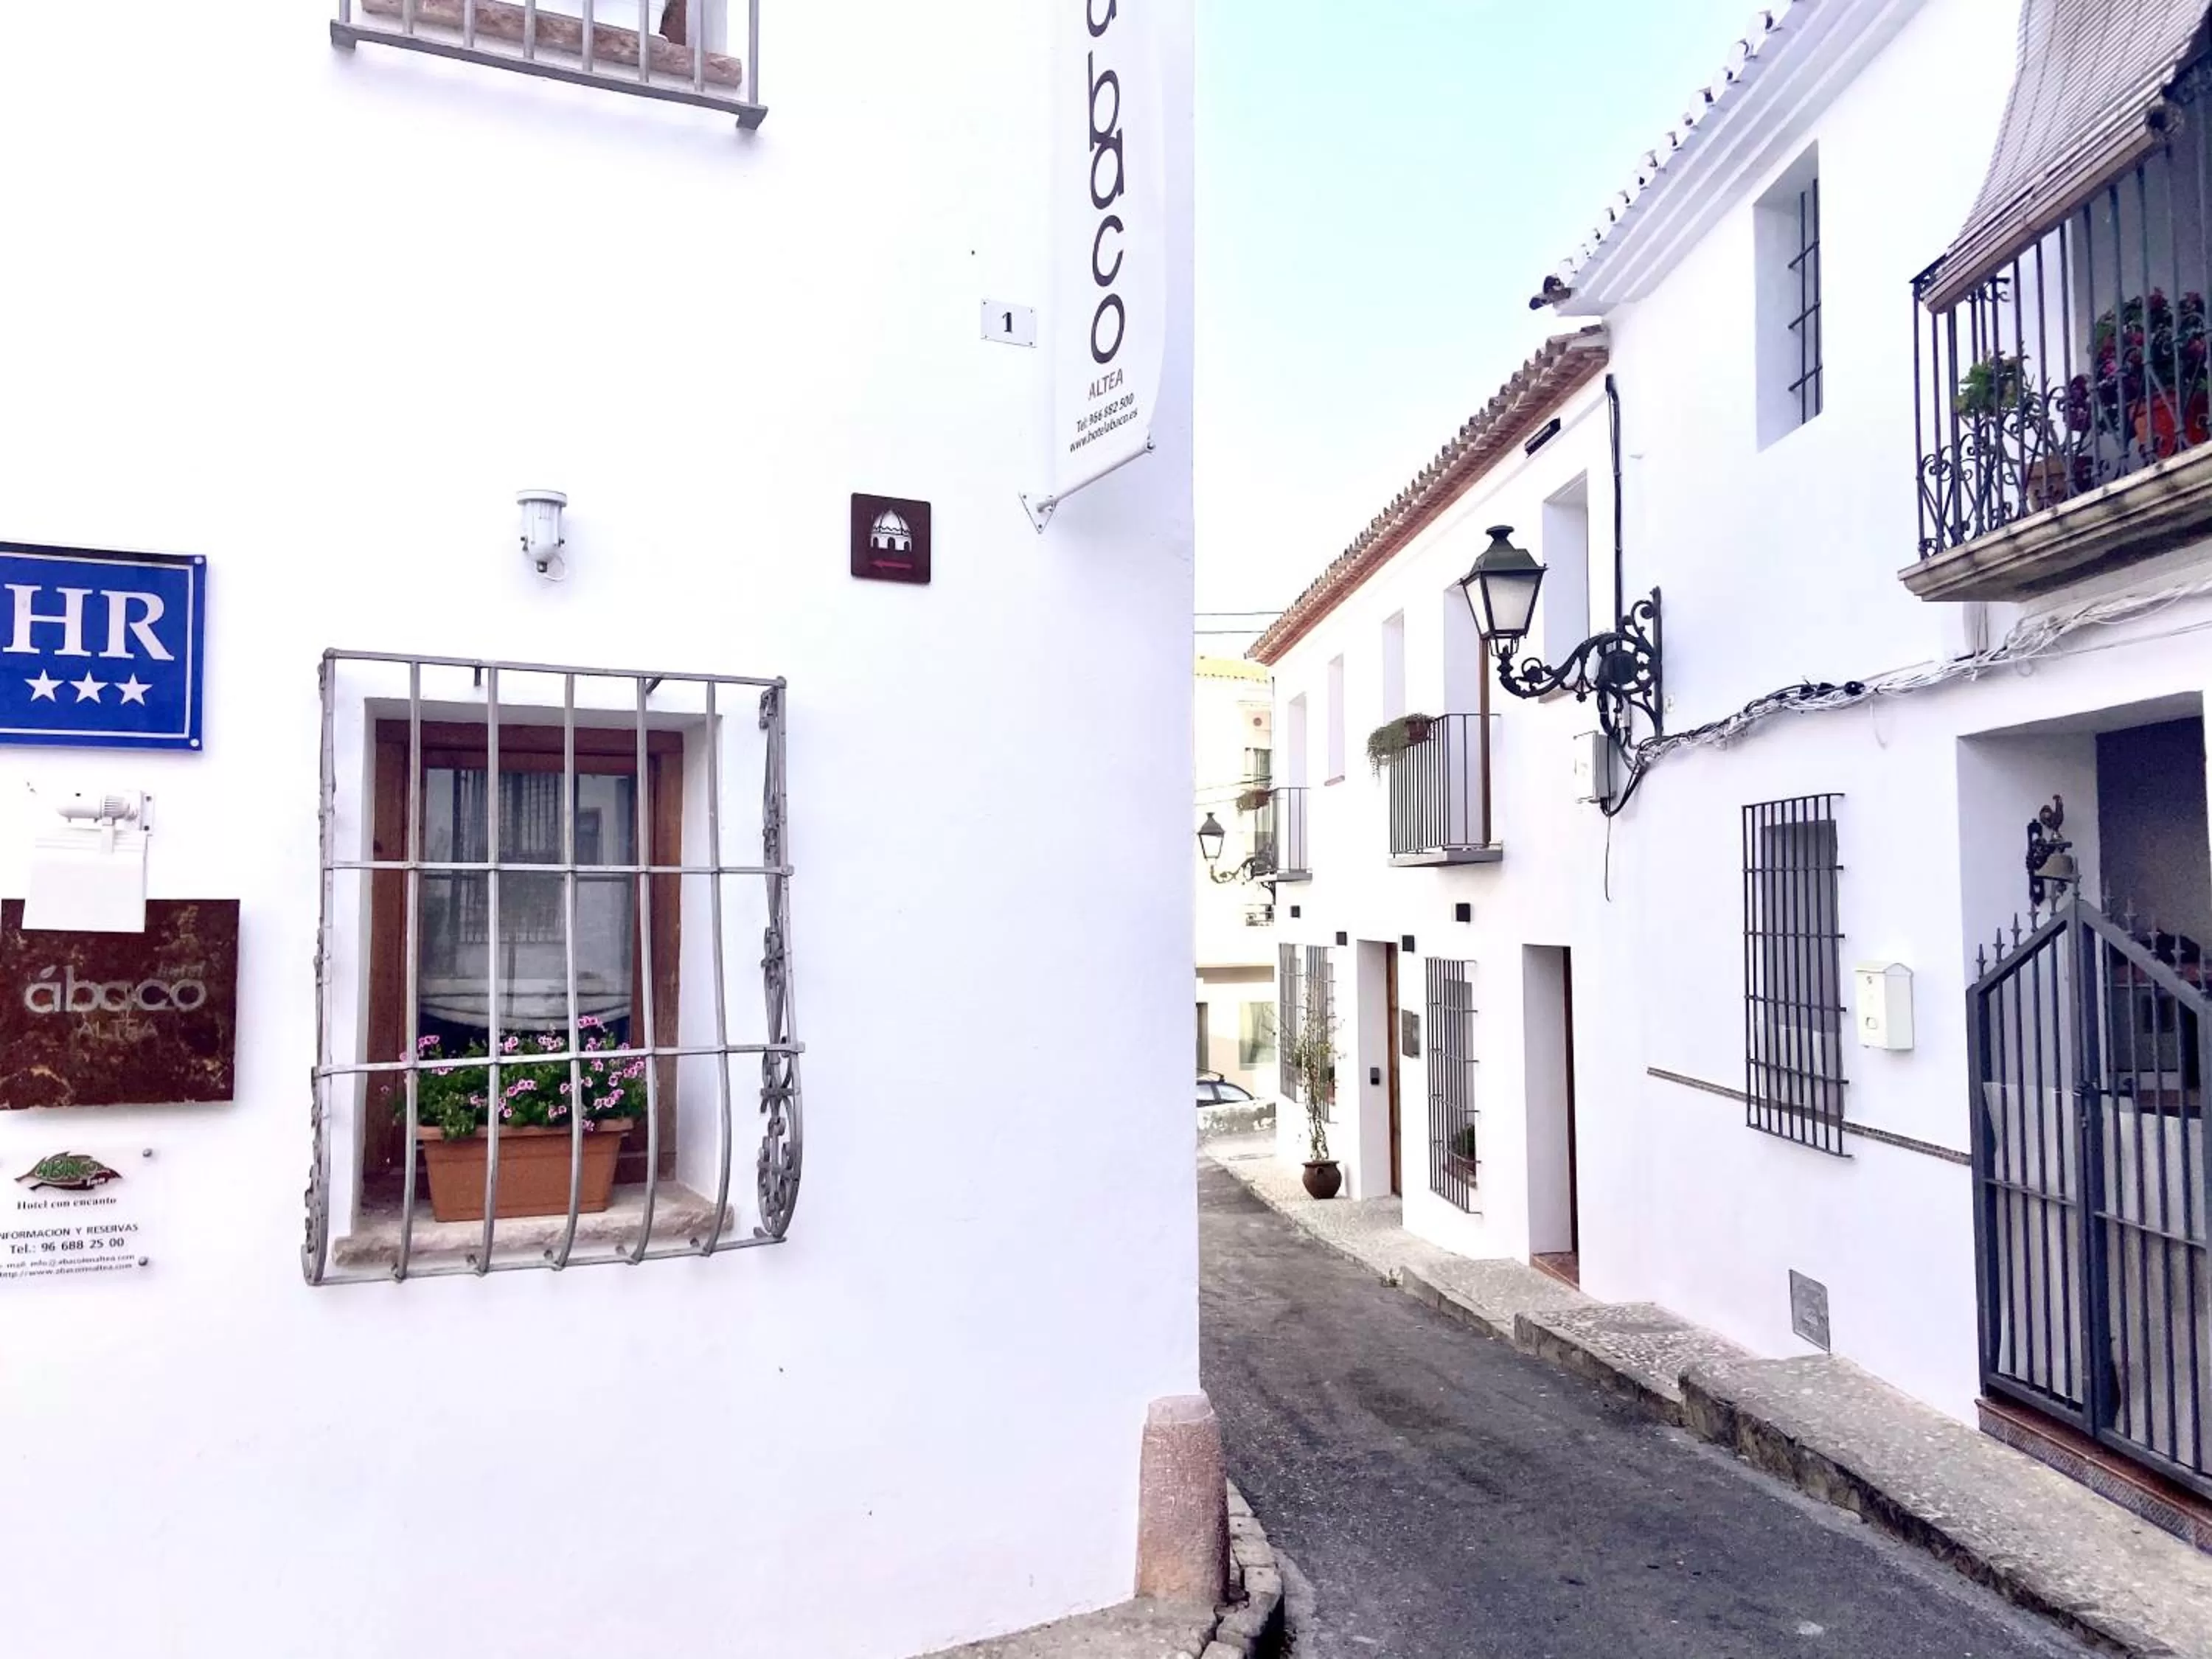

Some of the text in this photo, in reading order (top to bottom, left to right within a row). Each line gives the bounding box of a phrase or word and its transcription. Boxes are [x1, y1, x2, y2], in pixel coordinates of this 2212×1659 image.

[1002, 312, 1012, 333] 1
[1088, 368, 1123, 401] ALTEA
[2, 583, 175, 661] HR
[24, 964, 206, 1013] ábaco
[77, 1018, 159, 1040] ALTEA
[17, 1197, 116, 1210] Hotel con encanto
[75, 1227, 82, 1235] Y
[86, 1223, 138, 1235] RESERVAS
[41, 1241, 55, 1252] 96
[61, 1239, 83, 1251] 688
[89, 1239, 104, 1249] 25
[109, 1237, 125, 1248] 00
